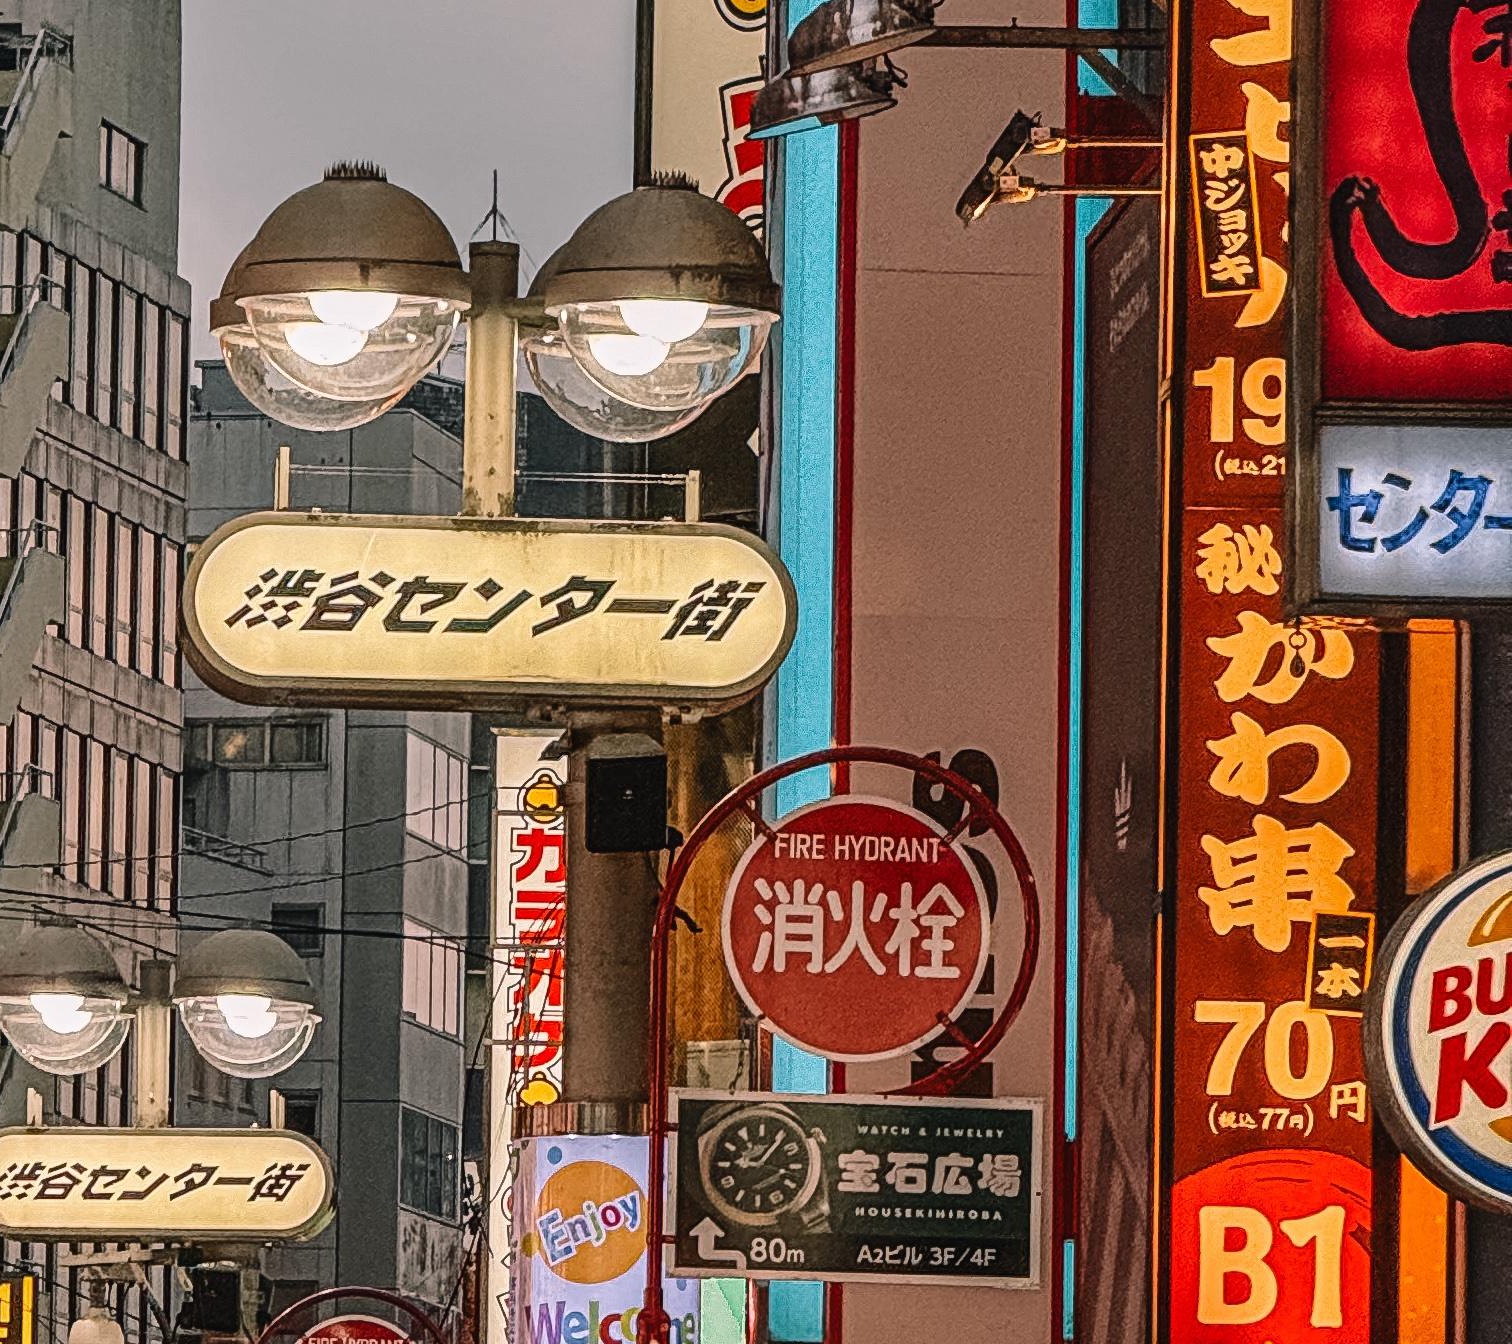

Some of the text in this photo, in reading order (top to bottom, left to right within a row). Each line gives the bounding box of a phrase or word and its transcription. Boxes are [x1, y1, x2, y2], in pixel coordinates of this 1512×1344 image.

[1198, 142, 1255, 286] 中ジョッキ
[223, 567, 767, 643] 渋谷センター街
[775, 832, 940, 864] FIRE HYDRANT
[751, 877, 965, 980] 消火栓
[1315, 932, 1365, 997] 一本
[1194, 999, 1335, 1100] 70
[1329, 1080, 1367, 1124] 円
[857, 1124, 911, 1137] WATCH
[935, 1128, 1005, 1140] JEWELRY
[837, 1151, 1023, 1198] 宝石広場
[538, 1190, 642, 1264] Enjoy
[855, 1206, 1003, 1221] HOUSEKIHIROBA
[749, 1236, 806, 1265] 80m
[857, 1244, 997, 1267] A2ビル 3F/4F
[1196, 1204, 1347, 1329] B1
